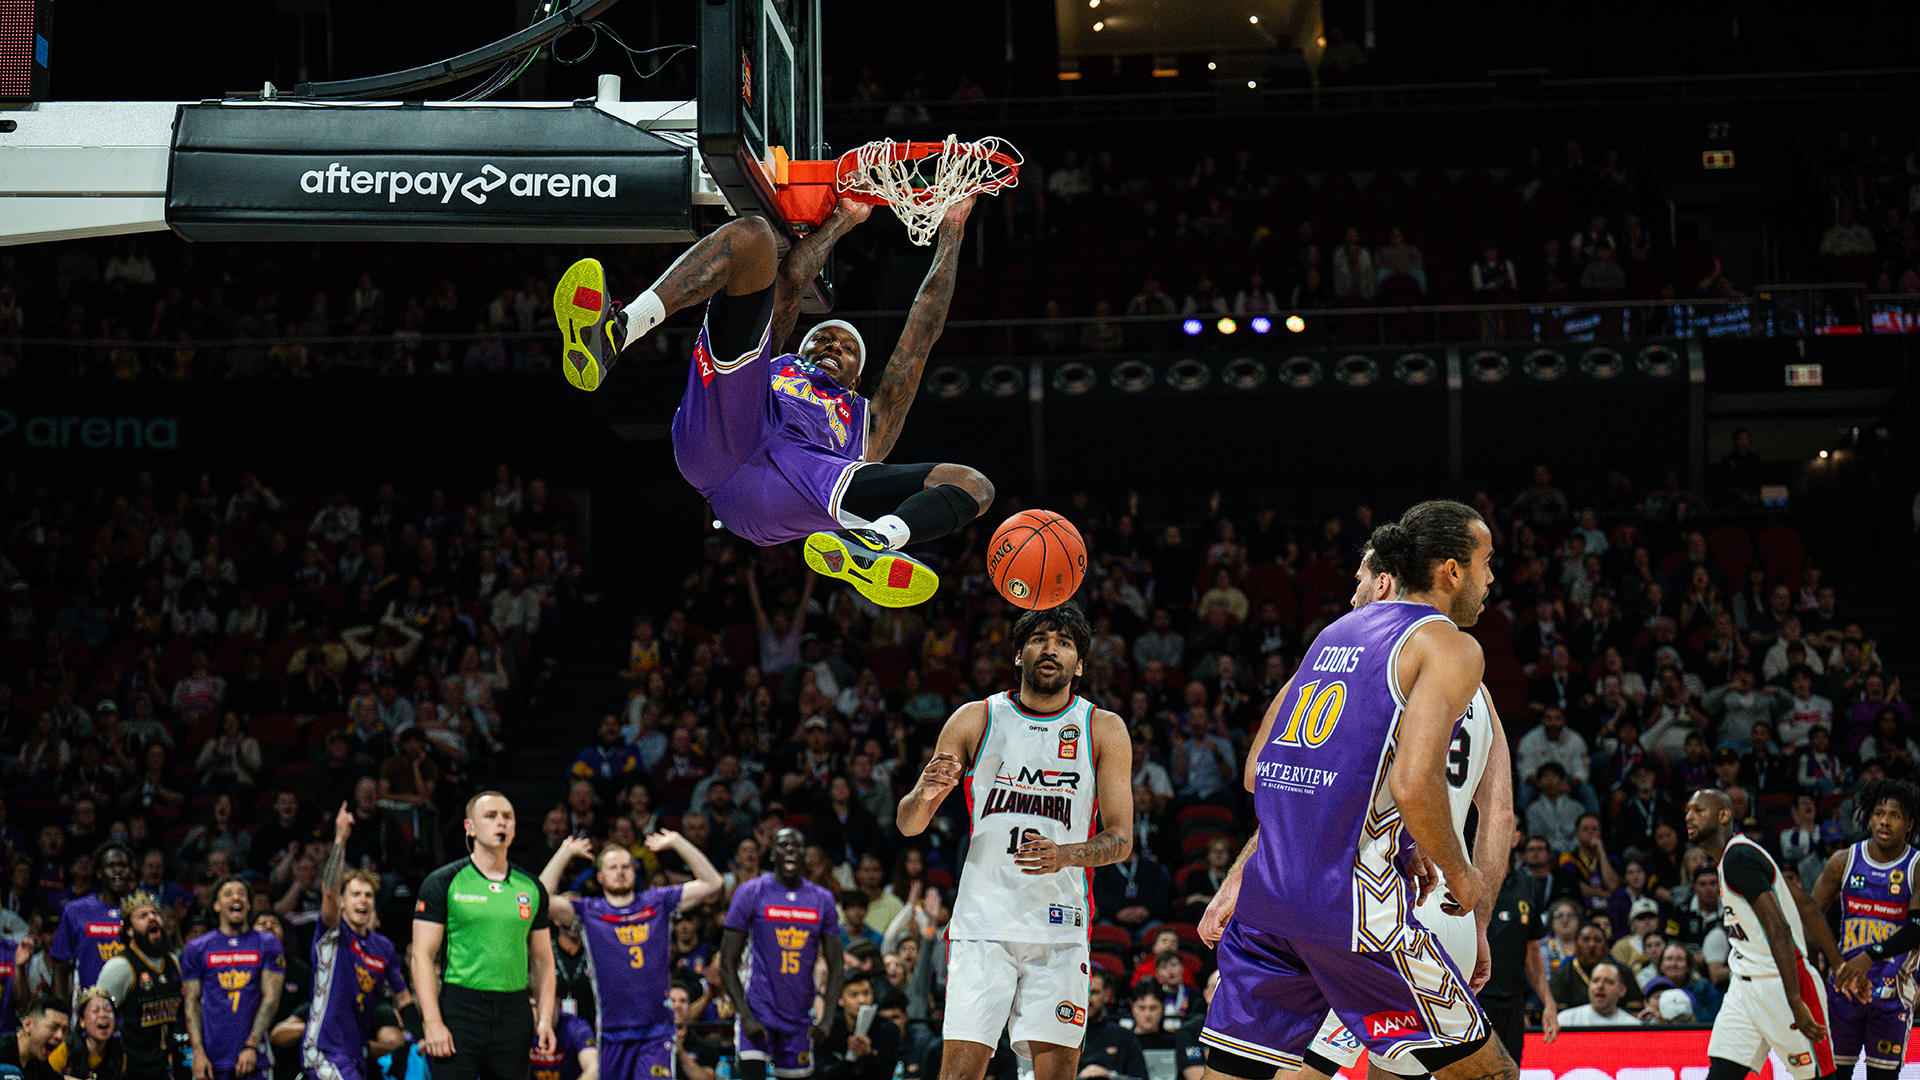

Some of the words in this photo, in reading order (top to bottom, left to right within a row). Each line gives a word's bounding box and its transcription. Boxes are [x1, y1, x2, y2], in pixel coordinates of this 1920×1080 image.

[300, 162, 463, 203] afterpay
[509, 172, 617, 197] arena
[24, 414, 178, 450] arena
[1312, 645, 1365, 673] COOKS
[1271, 678, 1348, 749] 10
[1062, 730, 1076, 739] NBL
[1017, 766, 1081, 790] MCR
[1256, 761, 1339, 788] WATERVIEW
[628, 946, 644, 969] 3
[780, 951, 801, 974] 15
[228, 990, 241, 1013] 7
[1373, 1015, 1418, 1036] AAMI
